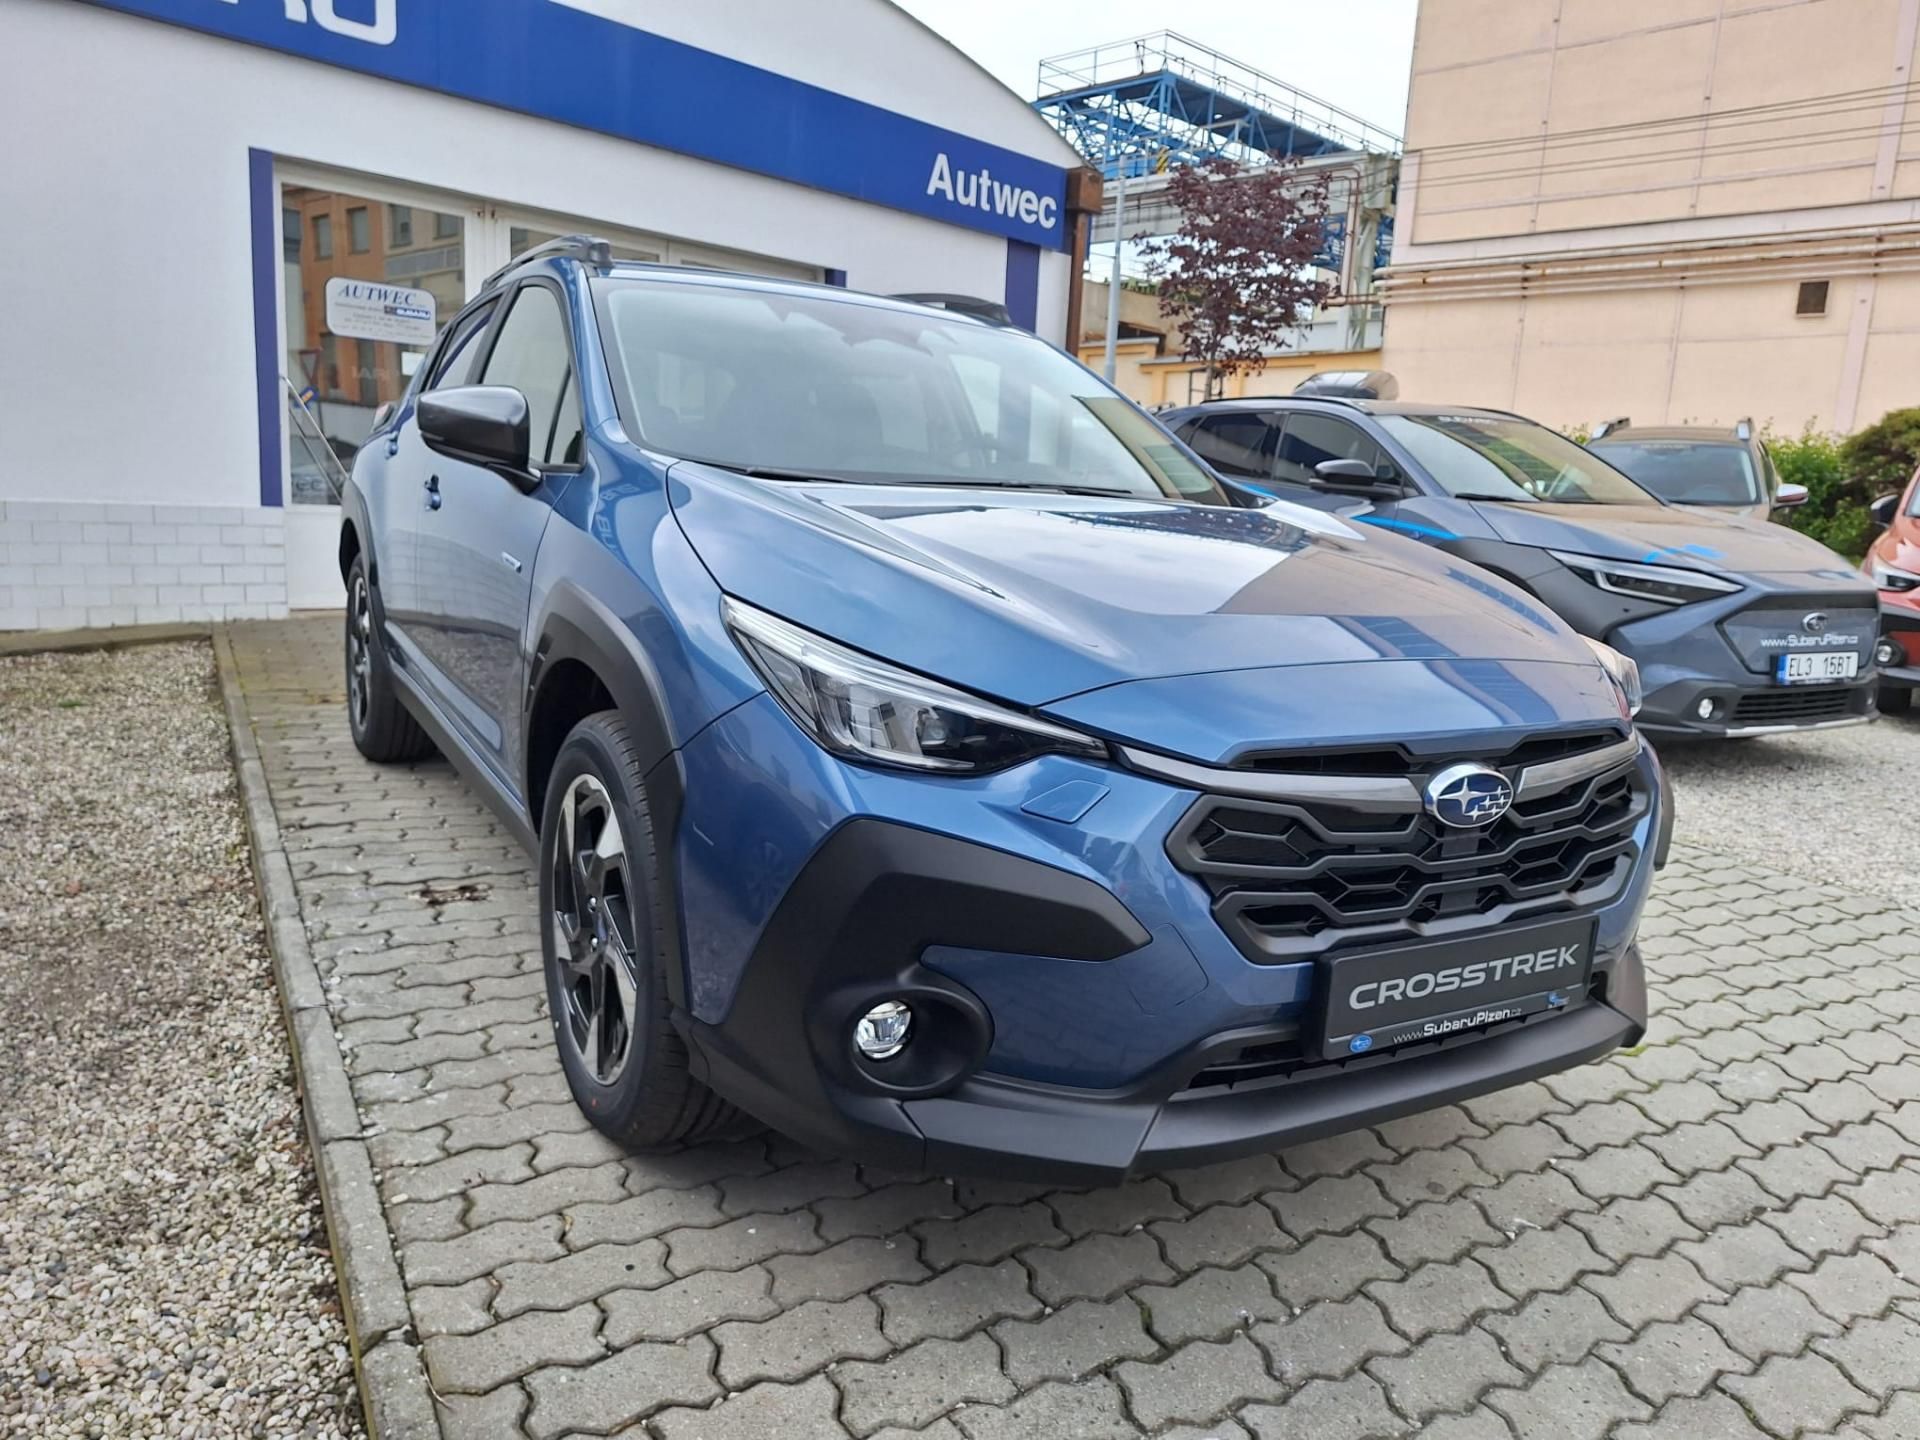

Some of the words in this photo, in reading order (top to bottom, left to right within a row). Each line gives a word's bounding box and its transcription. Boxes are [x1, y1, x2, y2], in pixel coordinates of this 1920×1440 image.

[926, 152, 1057, 230] Autwec
[339, 283, 417, 306] AUTWEC
[1788, 656, 1813, 677] EL3
[1349, 942, 1580, 1011] CROSSTREK
[1393, 1007, 1523, 1044] www.SubaruPlzen.cz
